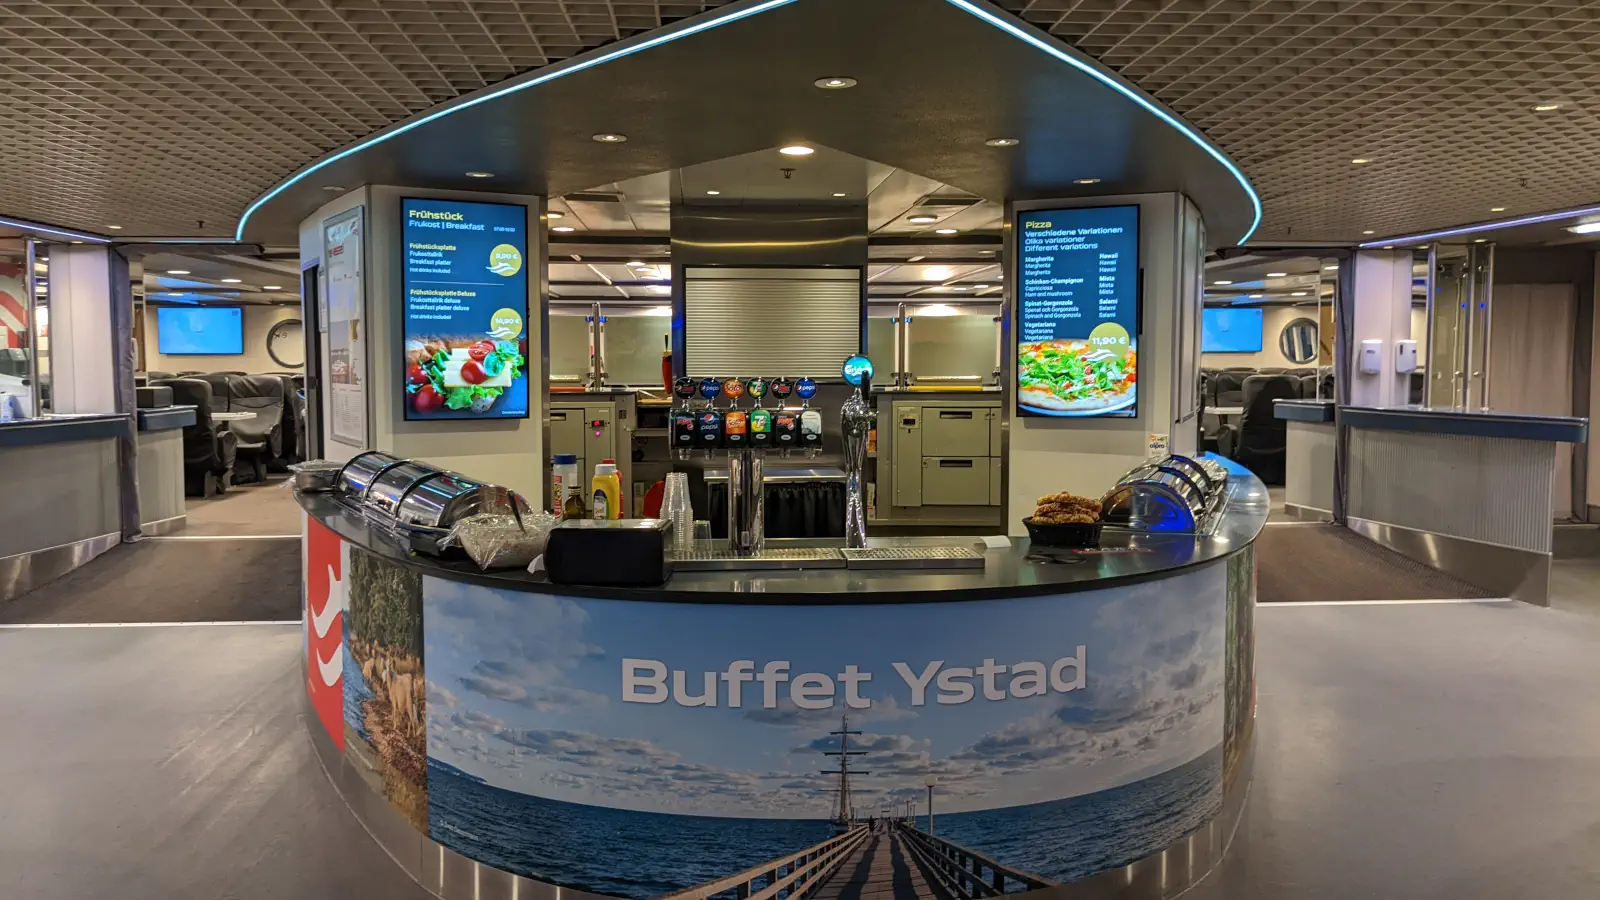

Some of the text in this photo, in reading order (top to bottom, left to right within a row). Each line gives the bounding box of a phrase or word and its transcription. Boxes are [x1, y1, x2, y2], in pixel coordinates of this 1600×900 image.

[409, 210, 464, 221] Frühstück
[409, 220, 441, 229] Frukost
[446, 222, 485, 231] Breakfast
[1025, 220, 1052, 229] Pizza
[1025, 227, 1123, 238] Verschiedene Variationen
[1044, 236, 1085, 244] variationer
[409, 243, 456, 251] Frühstücksplatte
[1060, 243, 1098, 251] variations
[1091, 336, 1126, 346] 11,90 €
[700, 423, 719, 431] pepsi
[621, 645, 1087, 710] Buffet Ystad
